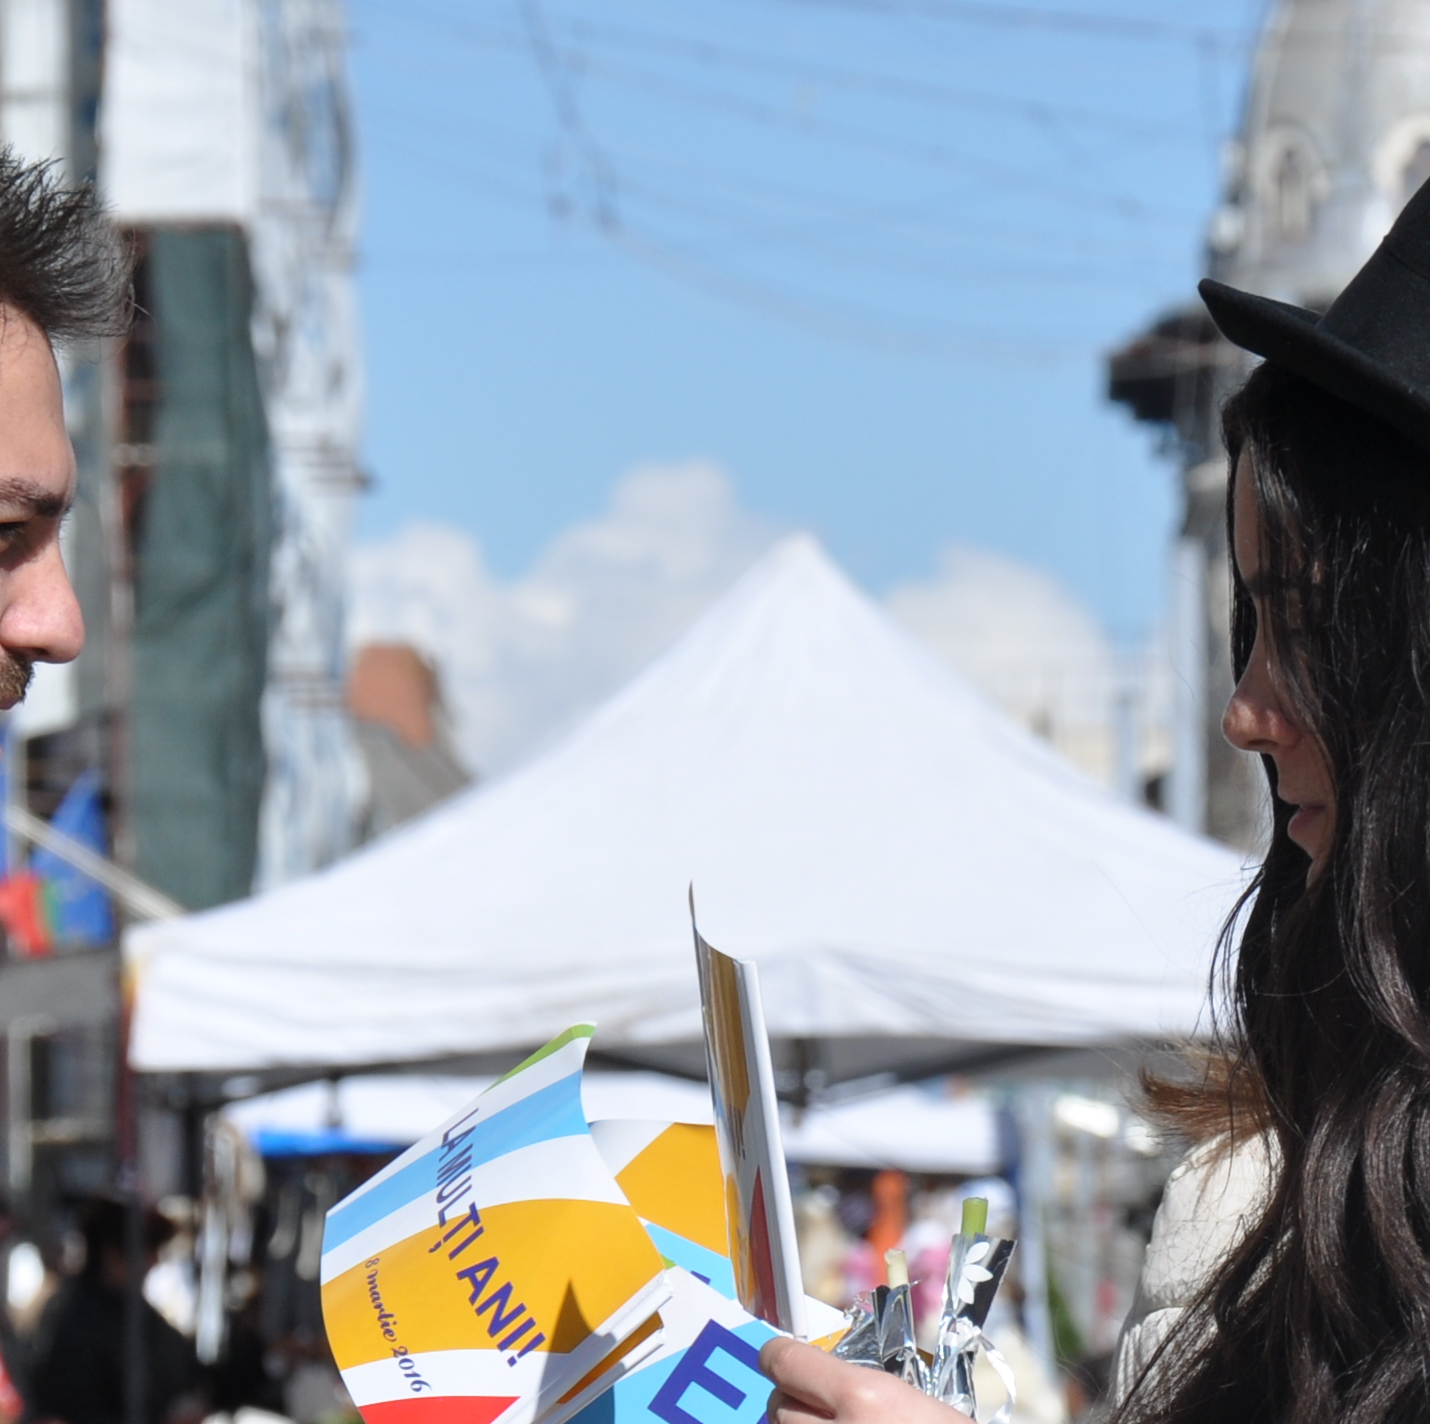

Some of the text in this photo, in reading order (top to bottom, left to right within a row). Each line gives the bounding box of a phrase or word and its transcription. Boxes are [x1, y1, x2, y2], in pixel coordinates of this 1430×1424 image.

[439, 1108, 479, 1162] LA
[365, 1257, 432, 1393] 8 martie 2016
[456, 1256, 546, 1368] ANI!
